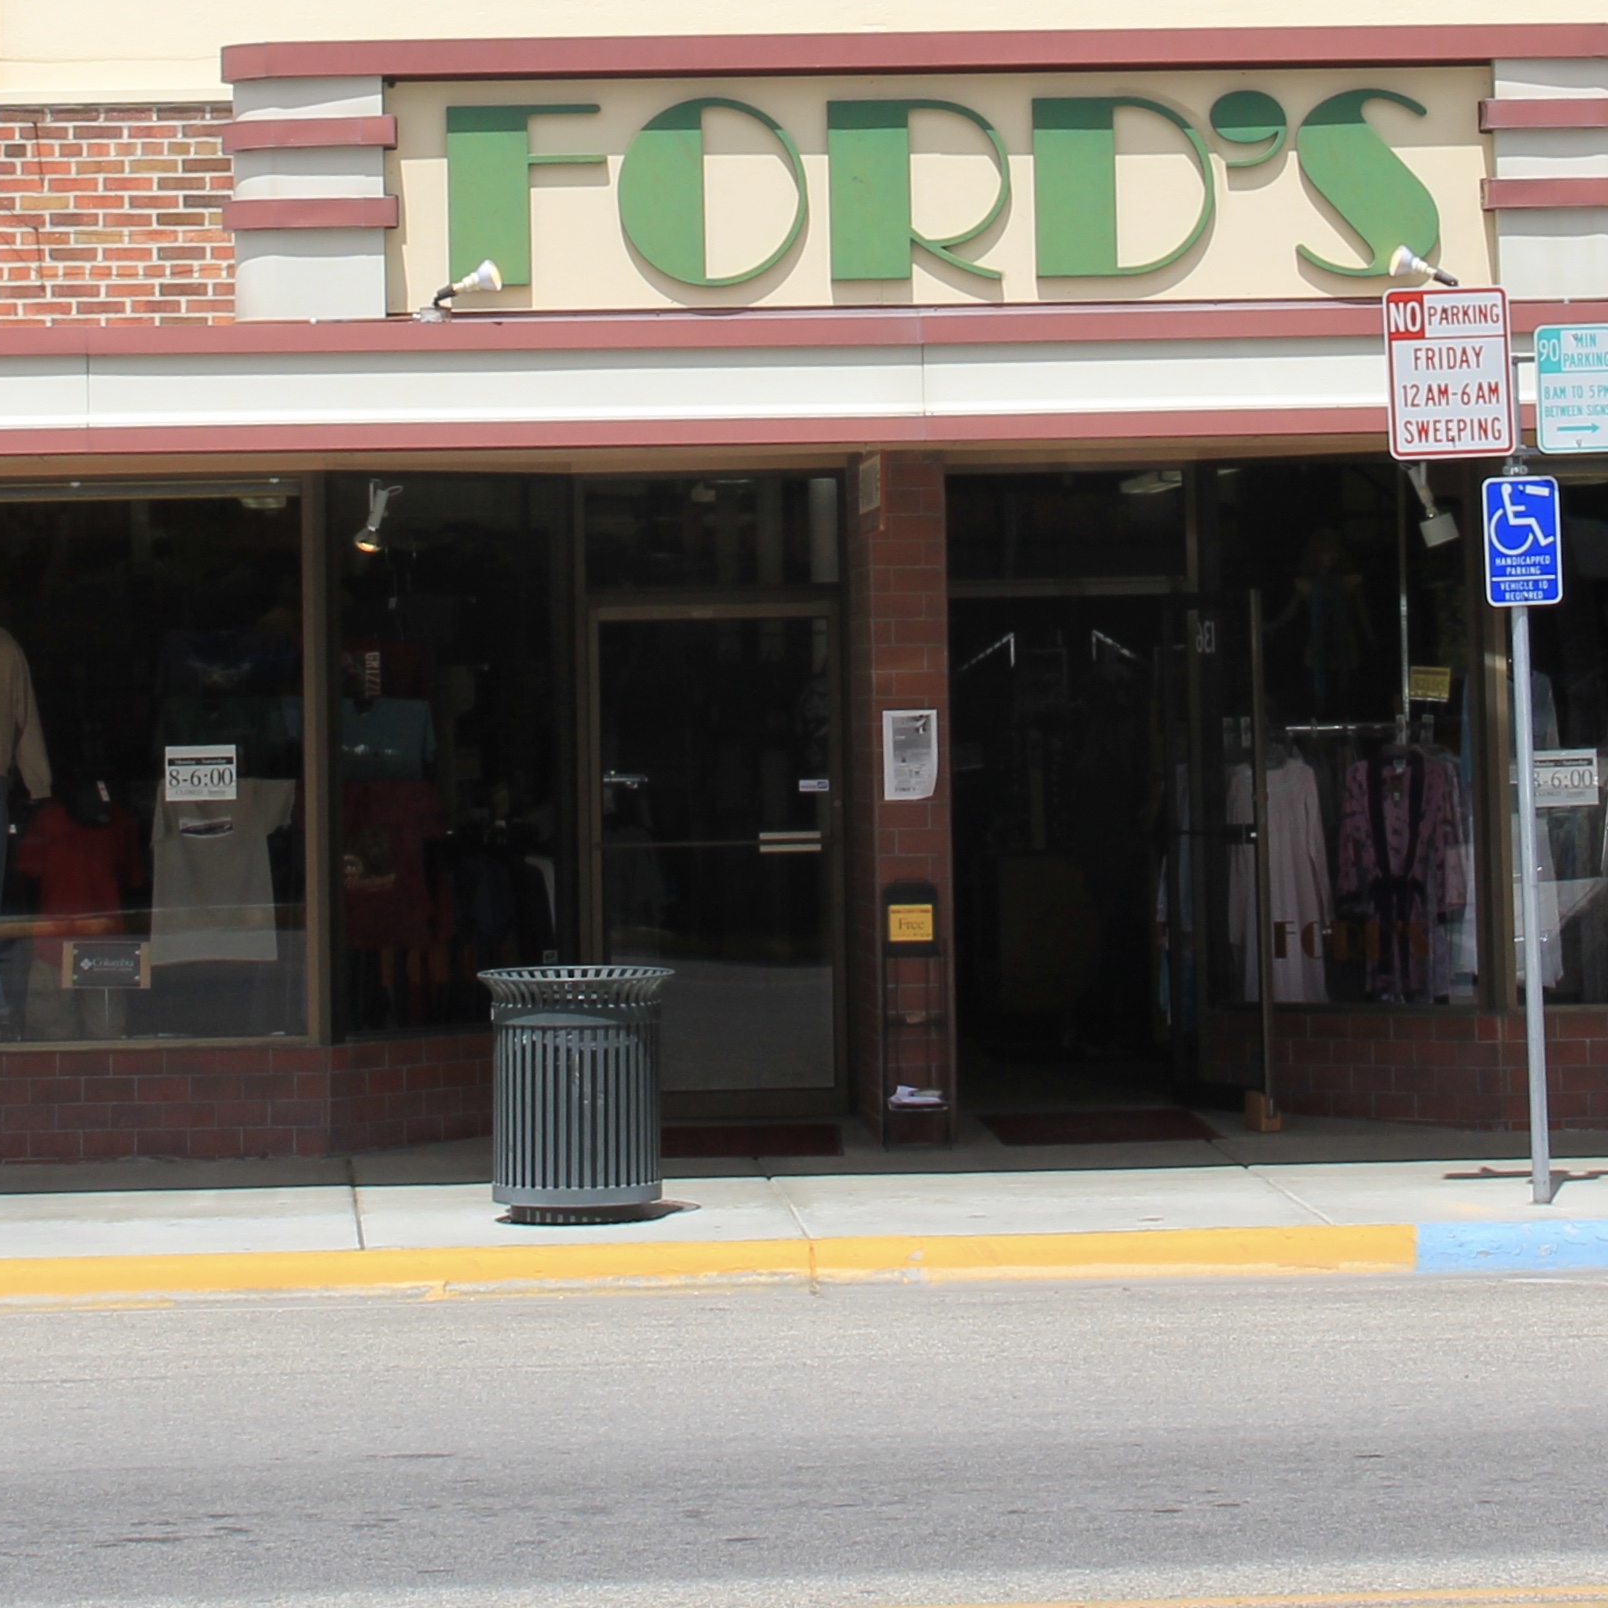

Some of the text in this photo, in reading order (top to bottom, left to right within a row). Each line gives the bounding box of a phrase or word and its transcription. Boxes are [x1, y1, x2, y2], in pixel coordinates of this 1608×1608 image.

[447, 88, 1440, 286] FORD'S
[1389, 301, 1499, 333] NO PARKING
[1574, 333, 1596, 348] MIN
[1539, 339, 1559, 362] 90
[1413, 345, 1483, 371] FRIDAY
[1571, 385, 1583, 399] TO
[1544, 405, 1583, 417] BETWEEN
[1403, 417, 1502, 444] SWEEPING
[1495, 555, 1551, 566] HANDICAPPED
[1506, 566, 1541, 575] PARKING
[1500, 580, 1548, 591] VEHICLE ID
[1505, 591, 1543, 601] REQURED
[169, 767, 233, 788] 8-6:00
[898, 918, 924, 930] Free
